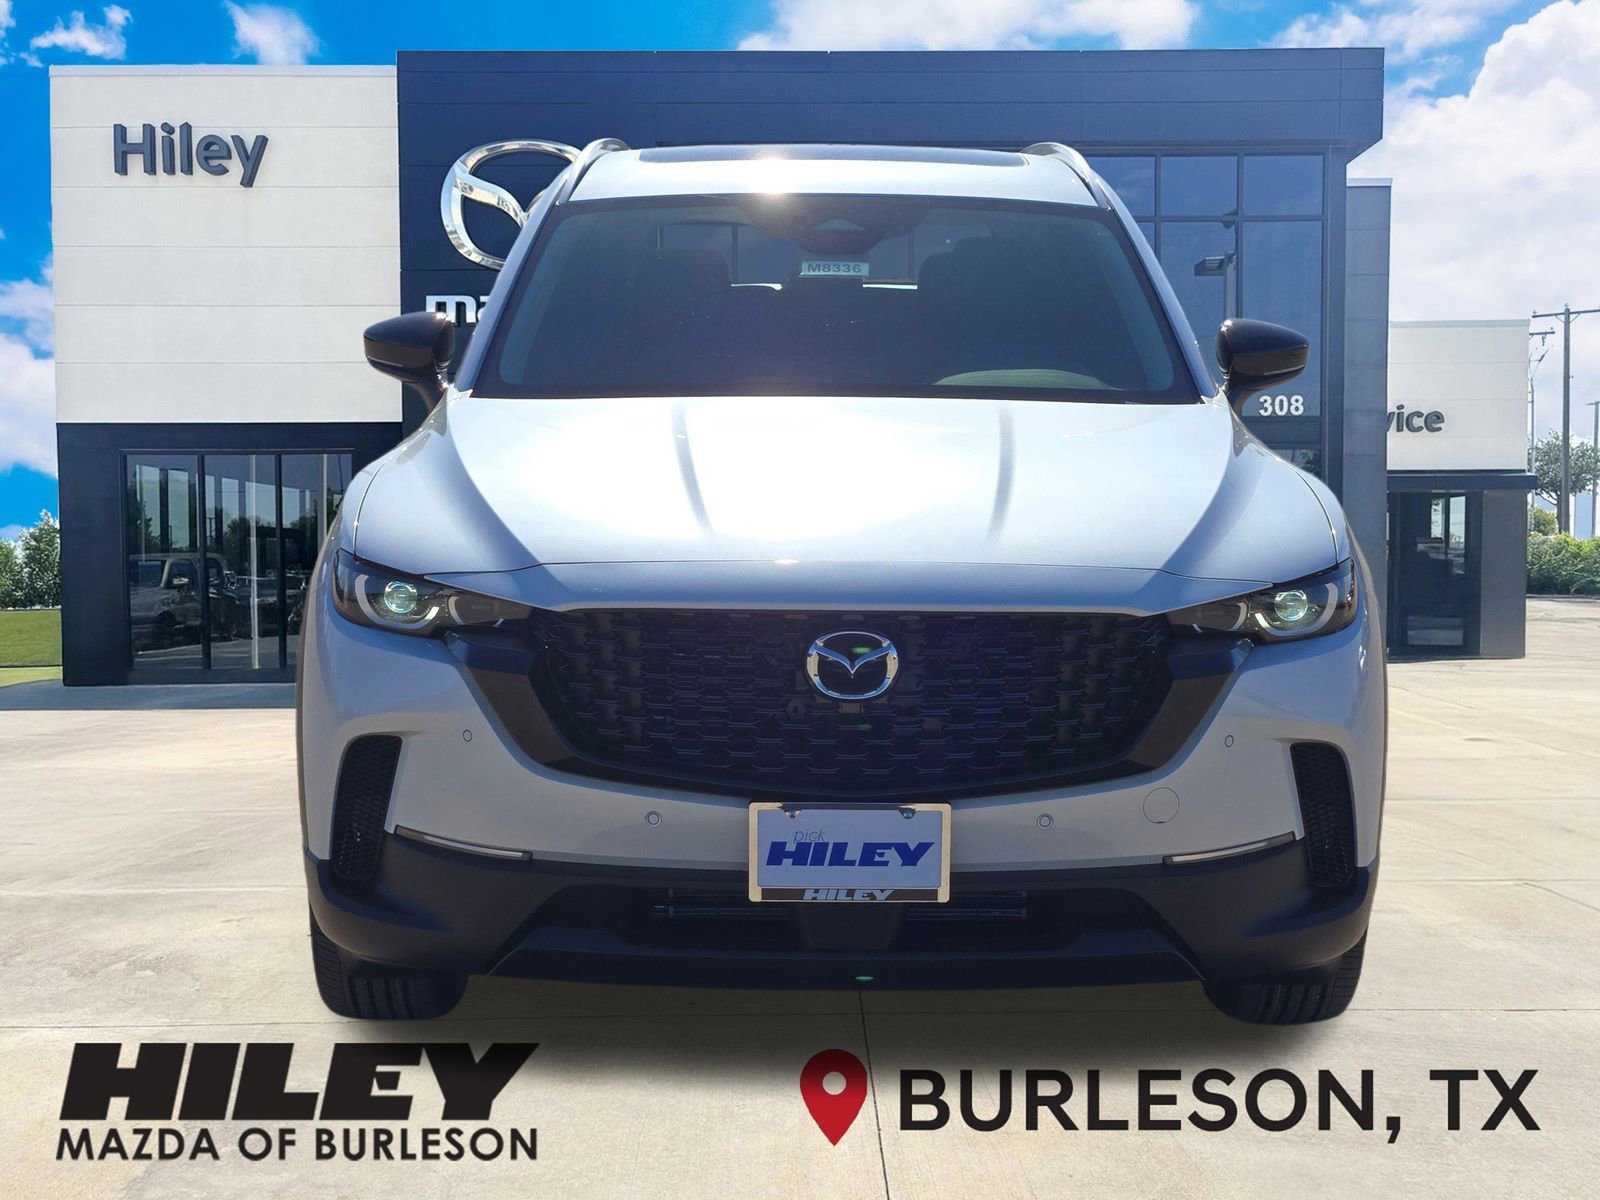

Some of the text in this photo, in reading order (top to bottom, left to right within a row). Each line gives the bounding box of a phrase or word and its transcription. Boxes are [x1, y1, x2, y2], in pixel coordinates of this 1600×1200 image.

[113, 121, 269, 188] Hiley
[807, 263, 862, 273] M8336
[1258, 394, 1305, 416] 308
[793, 829, 826, 844] pick
[766, 841, 934, 867] HILEY
[802, 888, 895, 901] HILEY
